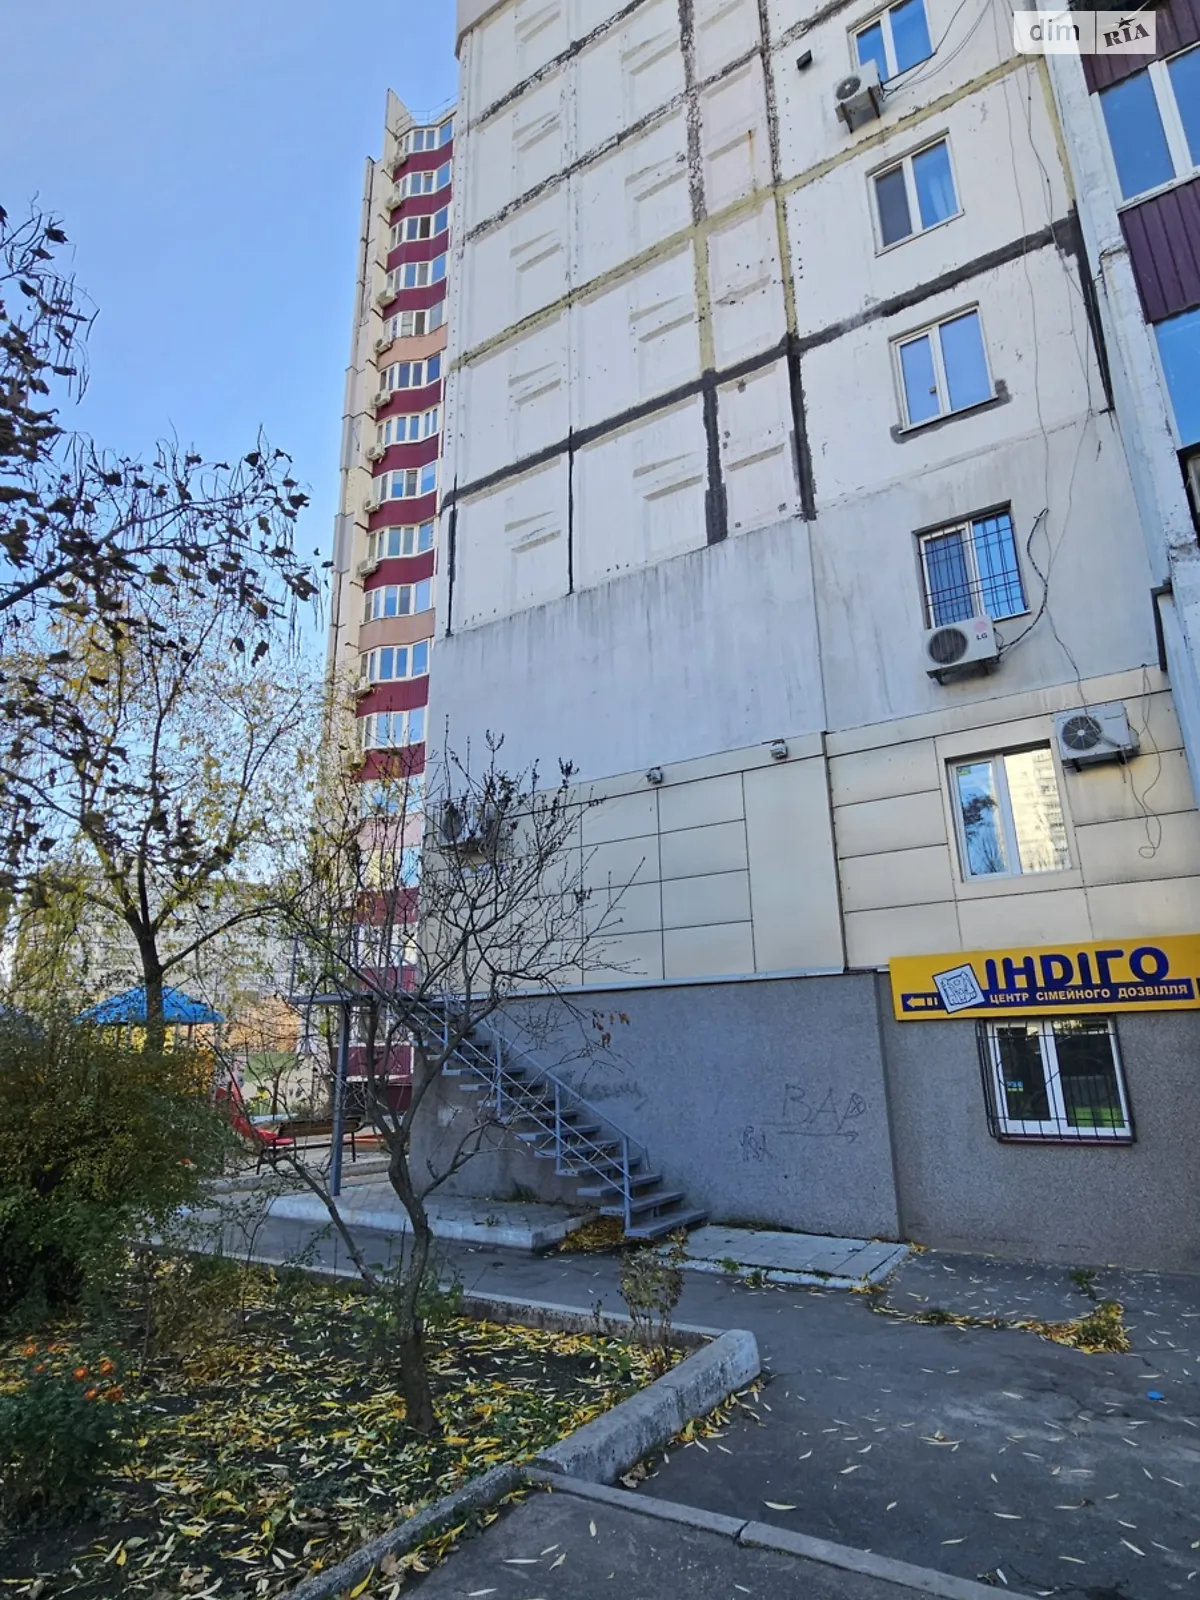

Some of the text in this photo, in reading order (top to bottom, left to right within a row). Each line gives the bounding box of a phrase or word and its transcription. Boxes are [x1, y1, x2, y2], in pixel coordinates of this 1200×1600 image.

[975, 632, 988, 641] LG
[989, 984, 1189, 1004] ЦЕНТР СІМЕЙНОГО ДОЗВІЛЛЯ
